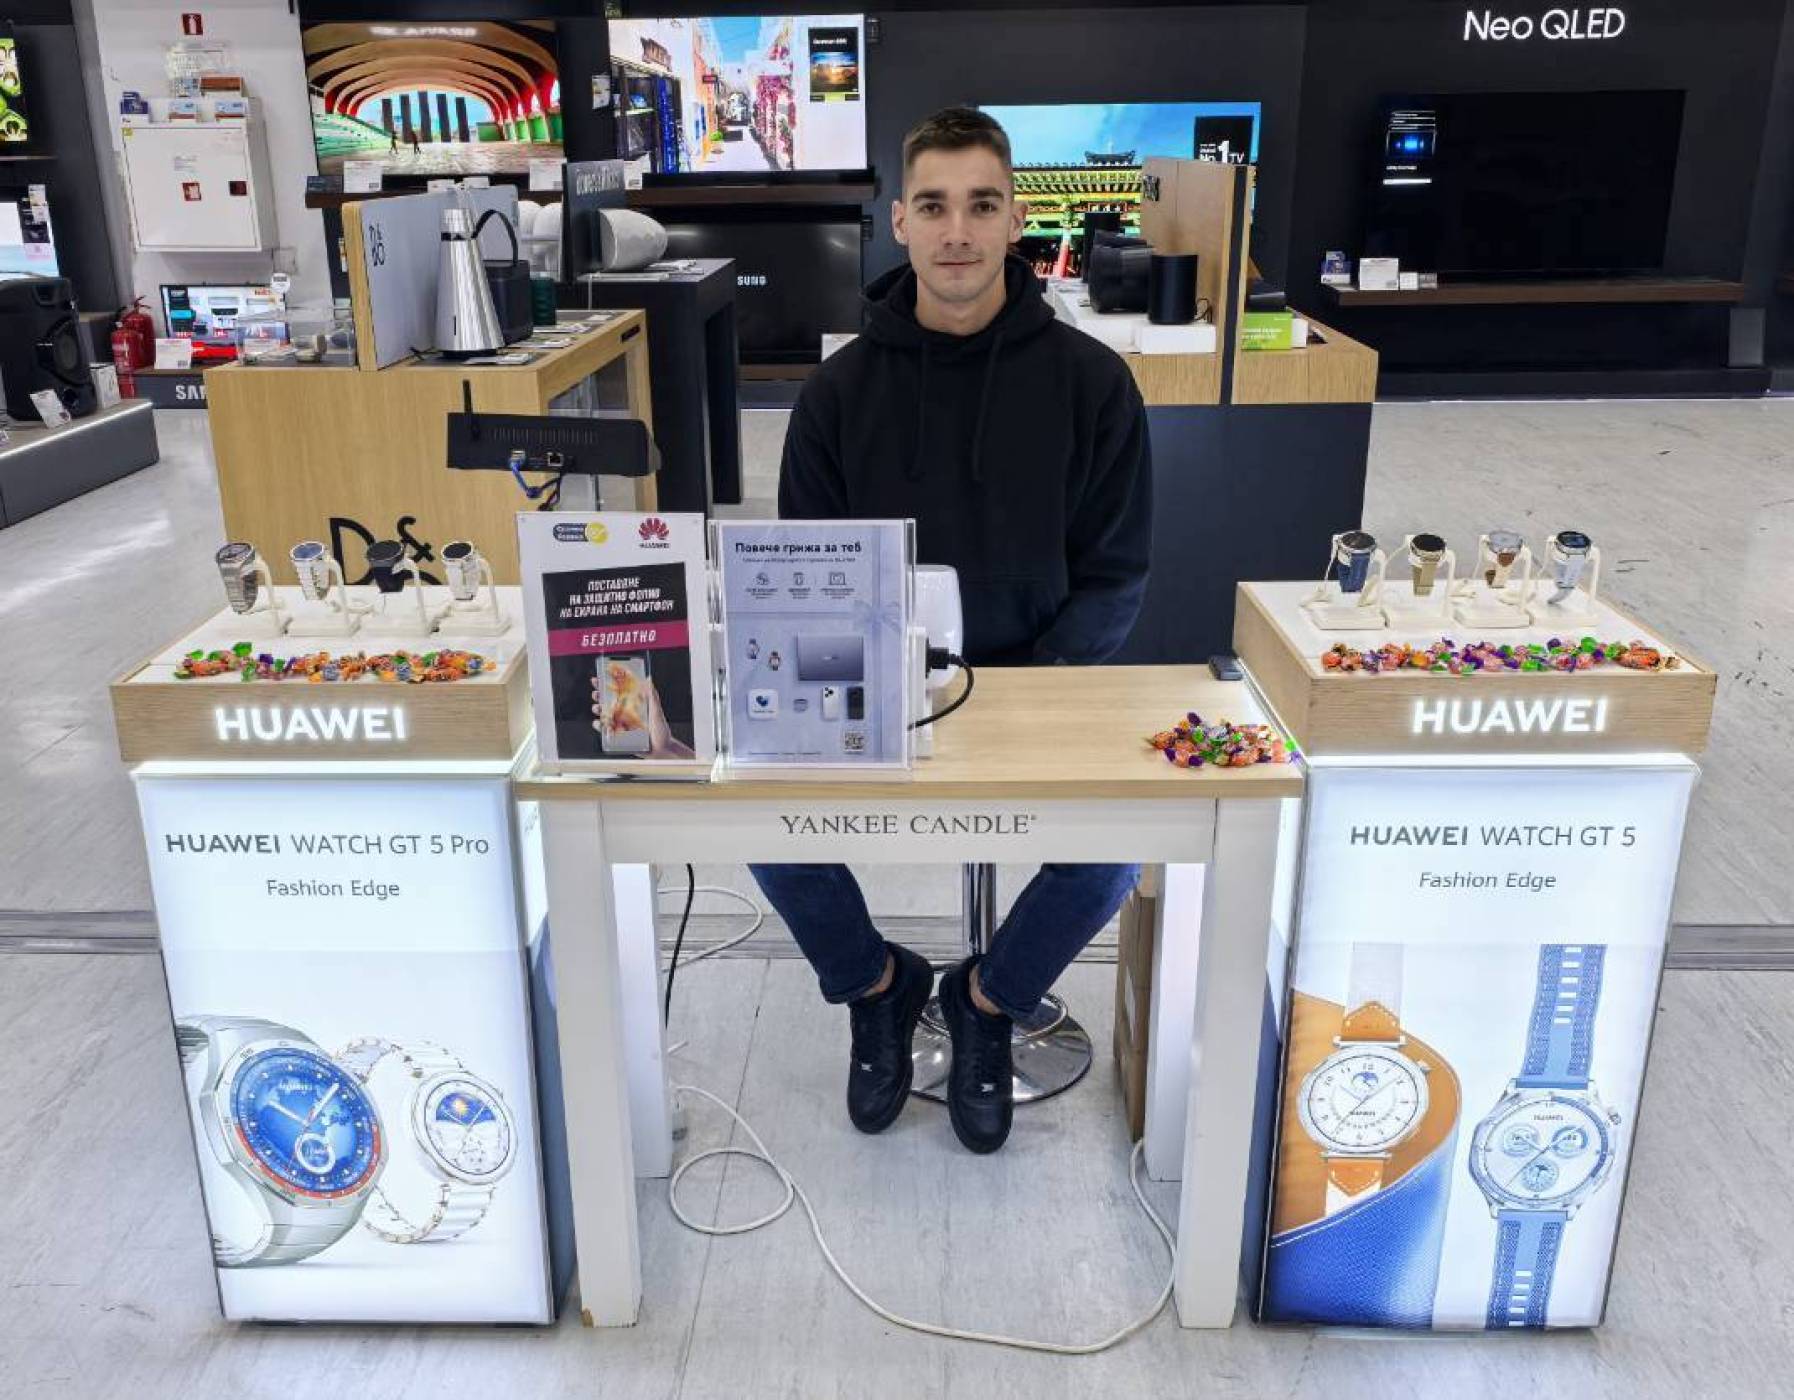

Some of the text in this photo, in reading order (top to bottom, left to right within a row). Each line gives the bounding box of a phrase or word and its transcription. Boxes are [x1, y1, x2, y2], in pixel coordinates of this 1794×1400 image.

[1463, 8, 1626, 41] Neo QLED
[1228, 151, 1245, 164] TV
[735, 541, 862, 556] Повече грижа за теб
[569, 594, 581, 606] НА
[584, 590, 627, 605] ЗАЩИТНО
[559, 599, 675, 618] НА ЕКРАНА НА СМАРТФОН
[580, 629, 657, 647] БЕЗПЛАТНО
[214, 706, 406, 741] HUAWEI
[1412, 697, 1609, 734] HUAWEI
[780, 815, 898, 834] YANKEE
[165, 833, 490, 855] HUAWEI WATCH GT 5 Pro
[1350, 825, 1637, 847] HUAWEI WATCH GT 5
[267, 879, 401, 900] Fashion Edge
[1419, 872, 1557, 892] Fashion Edge
